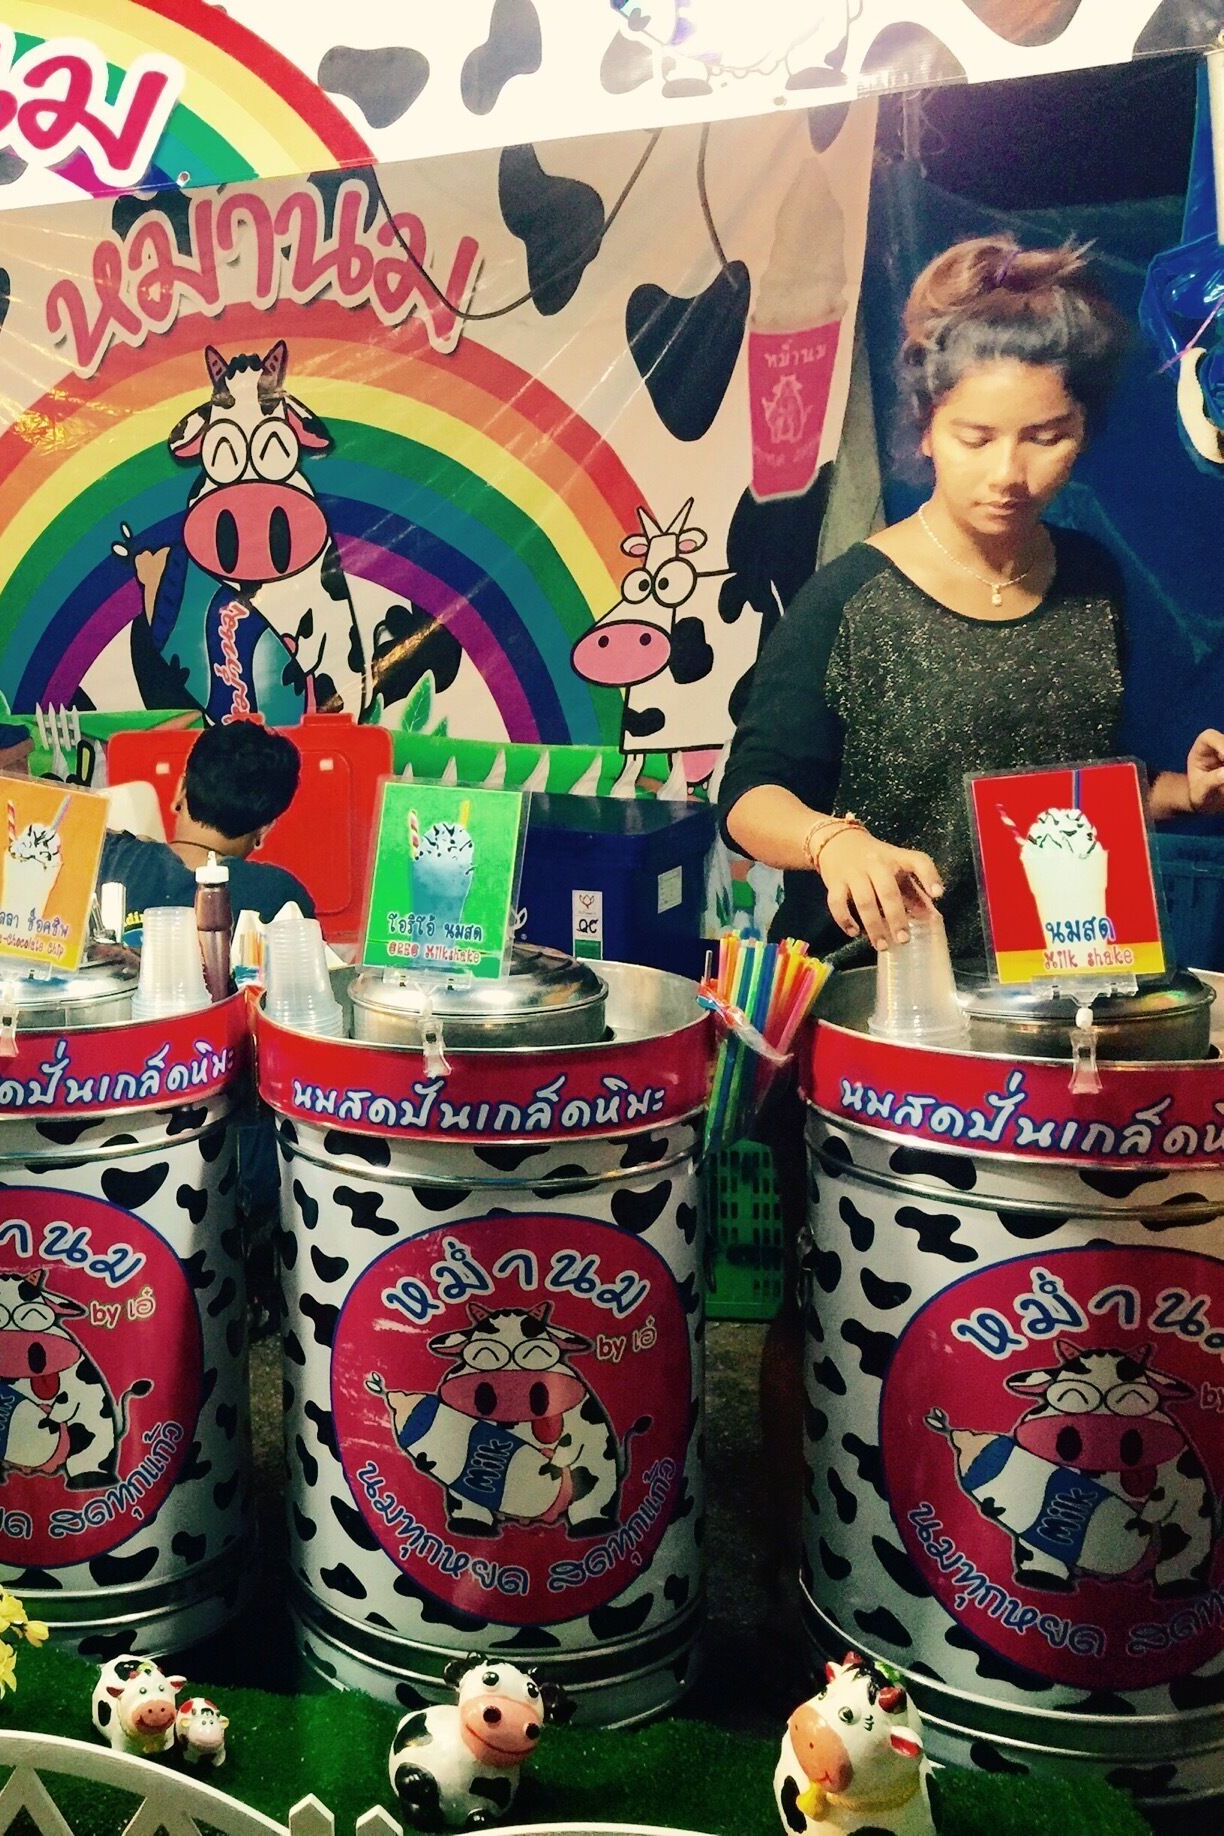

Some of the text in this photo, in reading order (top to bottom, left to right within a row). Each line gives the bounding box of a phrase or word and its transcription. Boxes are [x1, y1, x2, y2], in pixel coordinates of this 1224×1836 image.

[444, 923, 482, 942] นมสด
[1045, 915, 1115, 943] นมสด
[1043, 946, 1133, 969] Milk shake
[90, 1301, 120, 1328] by
[595, 1334, 625, 1363] by
[49, 1420, 184, 1539] สดทุกแก้ว
[463, 1438, 514, 1494] Milk
[356, 1461, 530, 1595] นมทุกหยด
[1035, 1486, 1099, 1546] Milk
[907, 1502, 1106, 1657] นมทุกหยด
